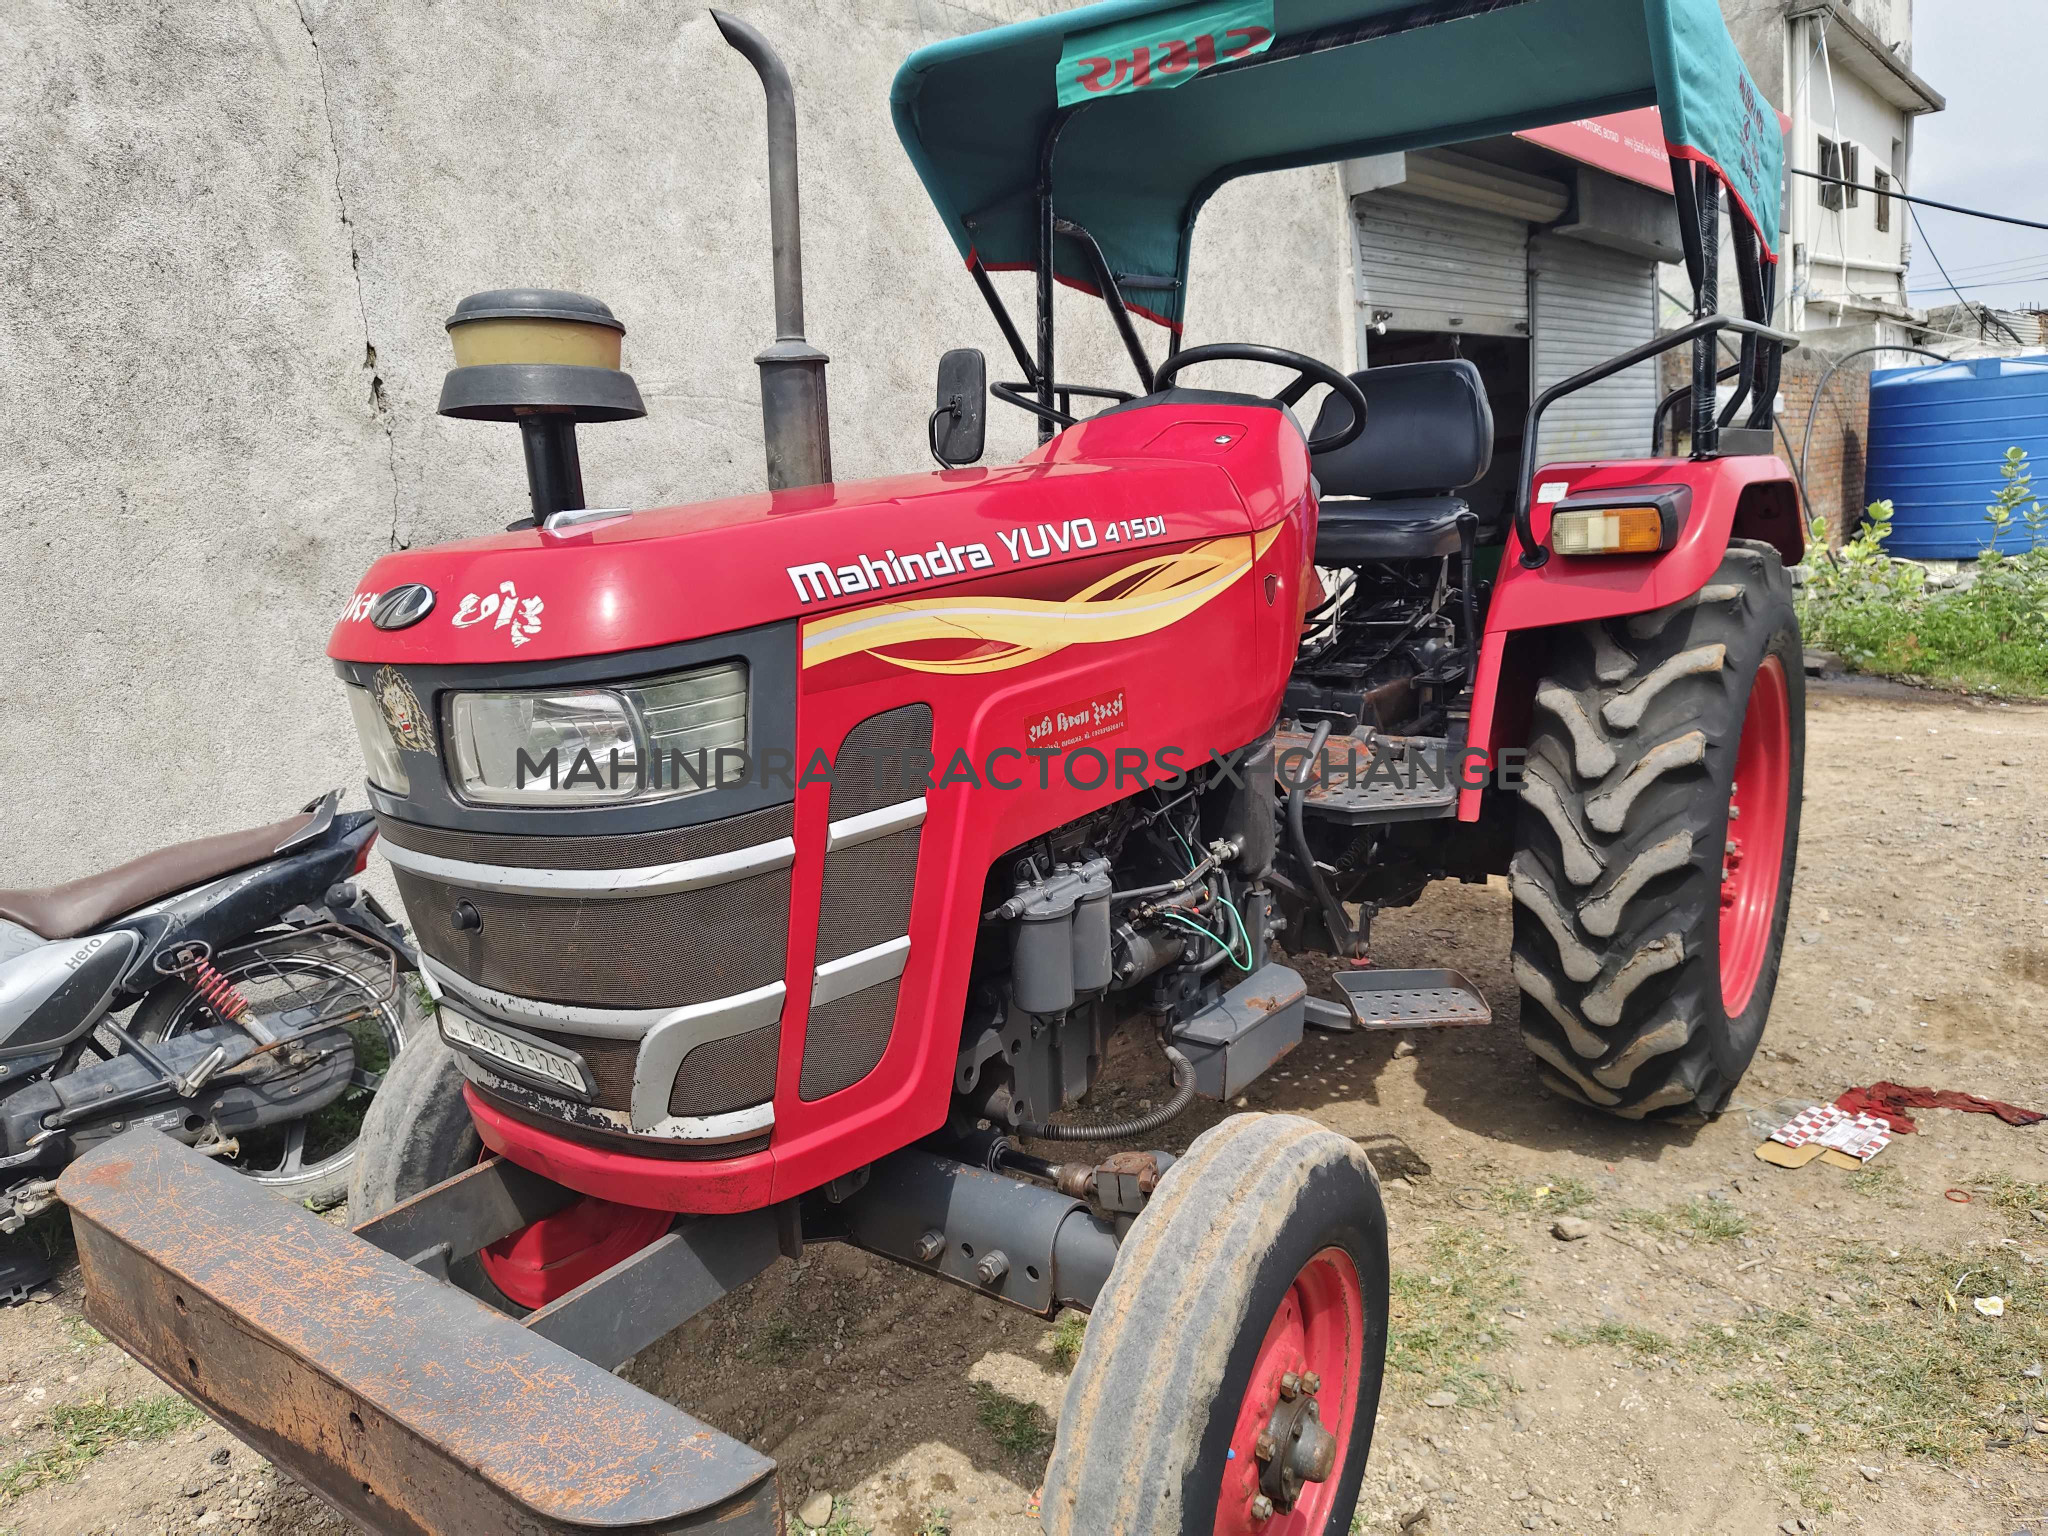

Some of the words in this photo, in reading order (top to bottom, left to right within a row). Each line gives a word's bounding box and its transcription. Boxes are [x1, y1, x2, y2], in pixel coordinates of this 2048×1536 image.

[1075, 26, 1272, 92] અમર
[786, 541, 995, 604] Mahindra
[996, 517, 1098, 563] YUVO
[1104, 515, 1167, 542] 415DI
[1028, 715, 1053, 743] રાધે
[64, 938, 102, 970] Hero
[510, 1041, 525, 1063] B
[531, 1048, 577, 1085] 3290
